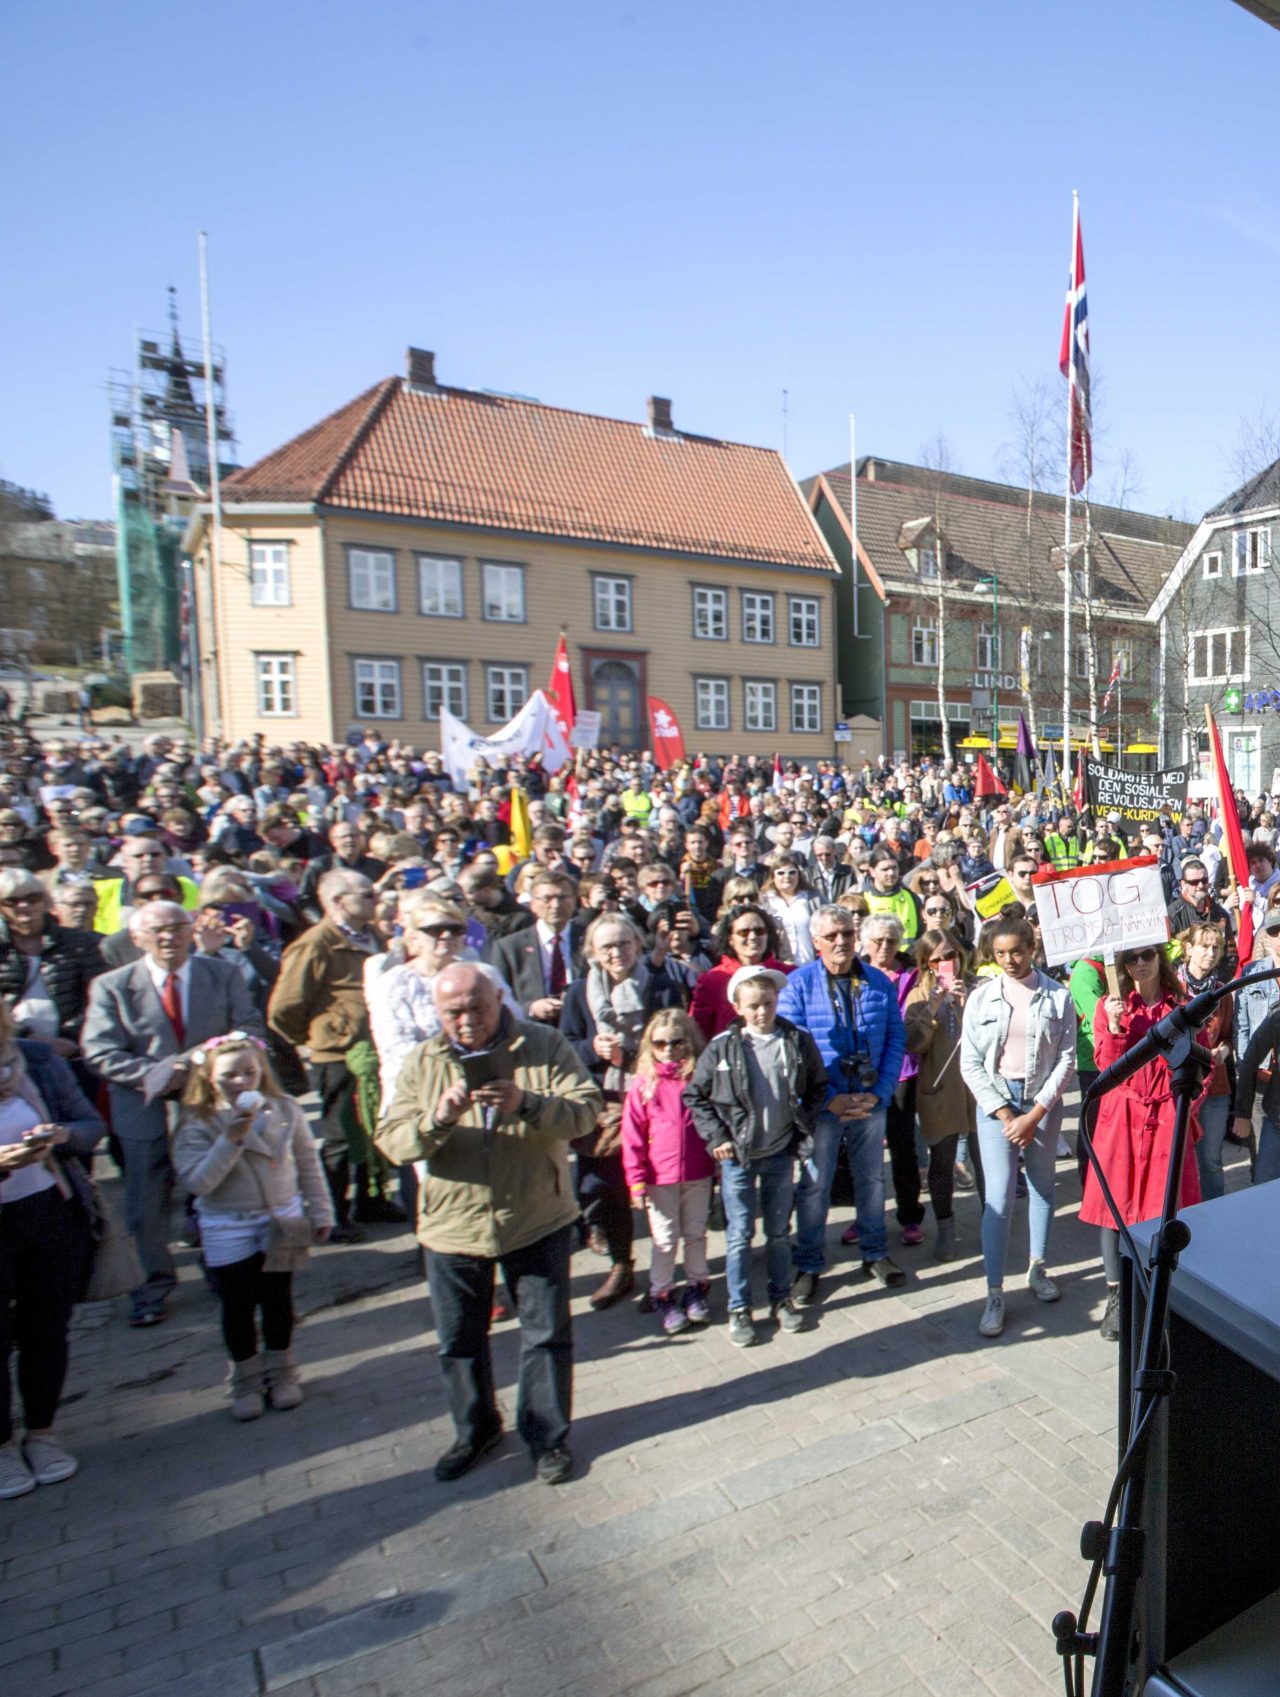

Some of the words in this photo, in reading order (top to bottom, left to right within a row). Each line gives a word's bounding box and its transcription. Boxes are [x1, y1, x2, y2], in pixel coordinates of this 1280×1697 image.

[1087, 763, 1156, 785] SOLIDARITET
[1162, 772, 1185, 785] MED
[1098, 778, 1121, 793] DEN
[1124, 783, 1171, 798] SOSIALE
[1035, 872, 1141, 919] TOG
